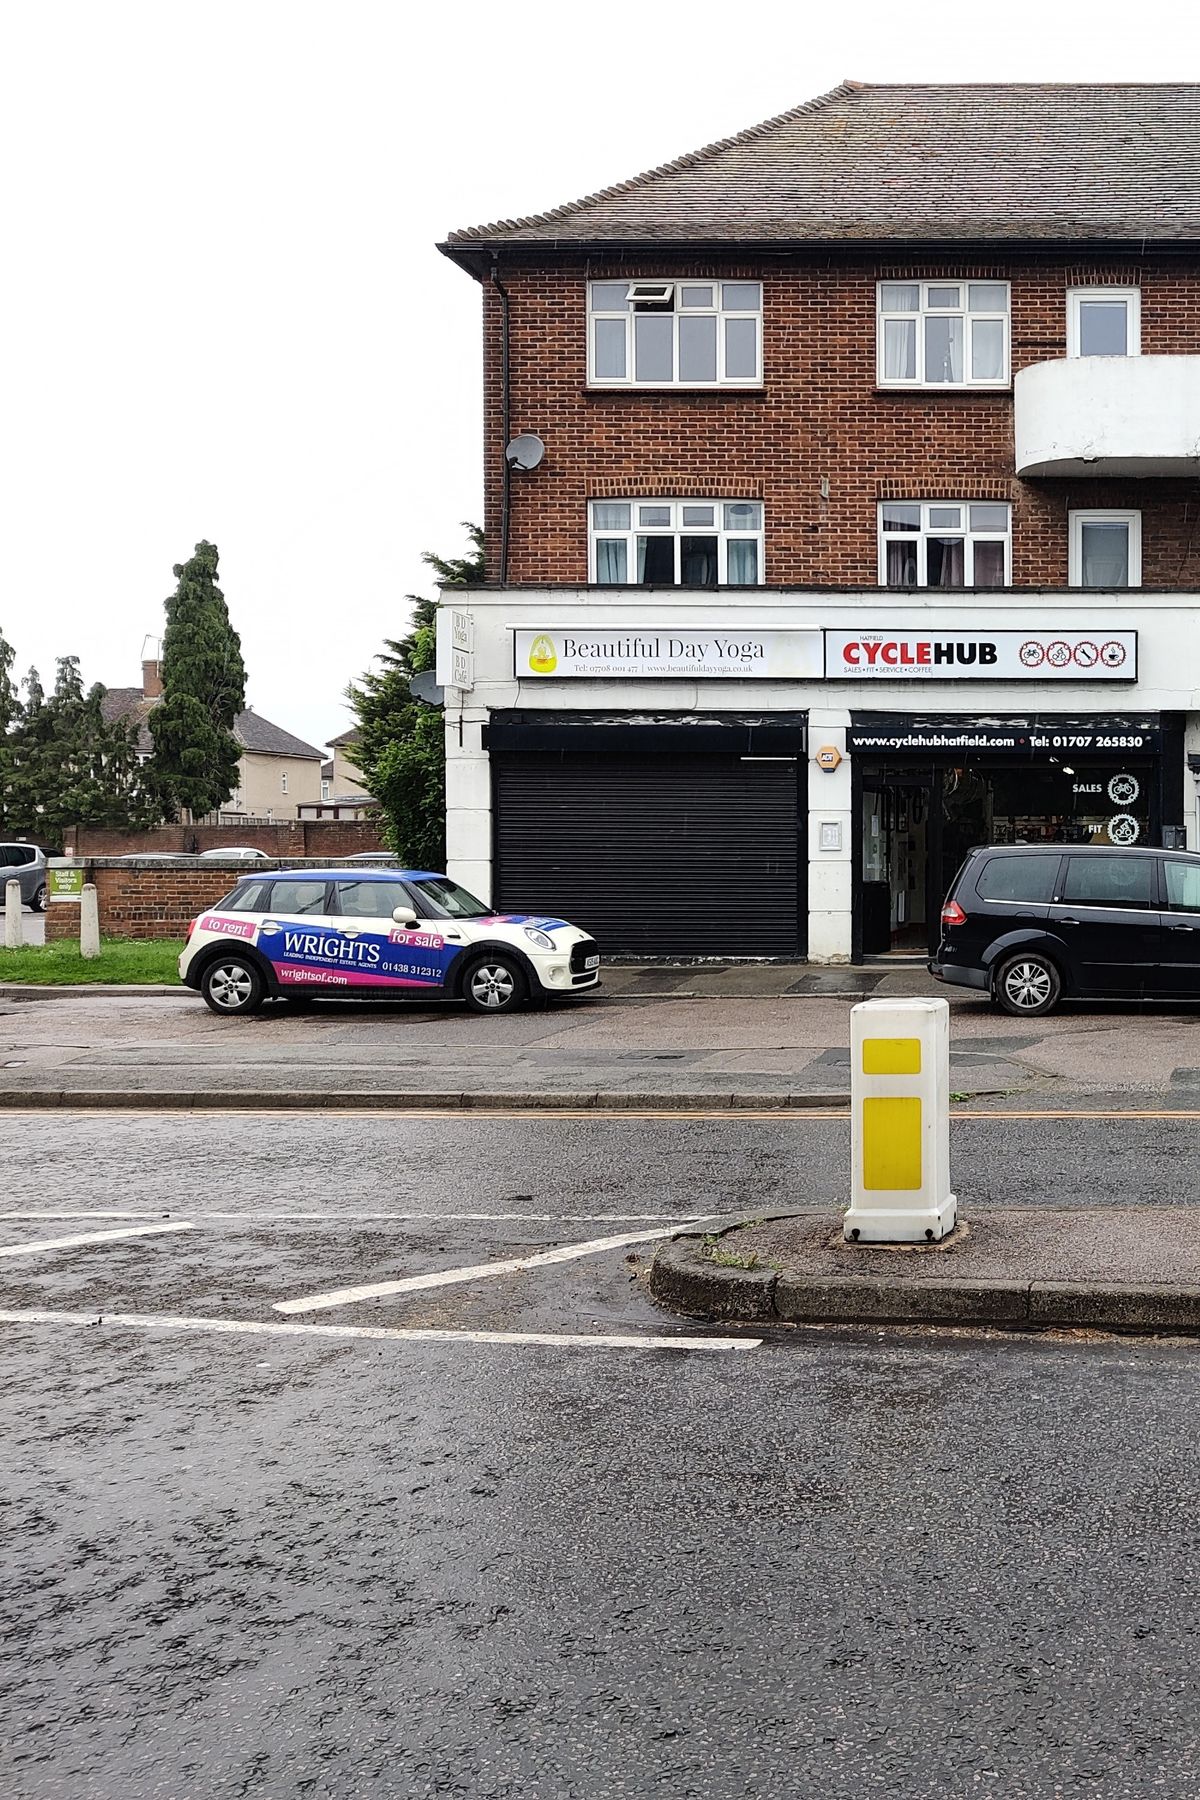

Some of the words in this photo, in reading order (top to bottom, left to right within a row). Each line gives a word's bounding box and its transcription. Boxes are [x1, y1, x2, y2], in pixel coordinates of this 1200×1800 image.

[563, 638, 660, 658] Beautiful
[669, 639, 709, 662] Day
[714, 639, 764, 662] Yoga
[843, 642, 998, 665] CYCLEHUB
[647, 664, 753, 674] www.beautifuldayyoga.co.uk
[852, 735, 1015, 749] www.cyclehubhatfield.com
[1029, 736, 1050, 747] Tel:
[1053, 736, 1092, 747] 01707
[1096, 736, 1143, 747] 265830
[1072, 784, 1102, 793] SALES
[1088, 825, 1103, 833] FIT
[207, 919, 220, 930] to
[222, 922, 248, 935] rent
[284, 932, 381, 963] WRIGHTS
[392, 931, 411, 944] for
[414, 935, 441, 948] sale
[305, 955, 338, 964] INDEPENDENT
[339, 959, 357, 967] ESTATE
[382, 961, 409, 973] 01438
[410, 965, 442, 977] 312312
[280, 969, 348, 985] wrightsof.com
